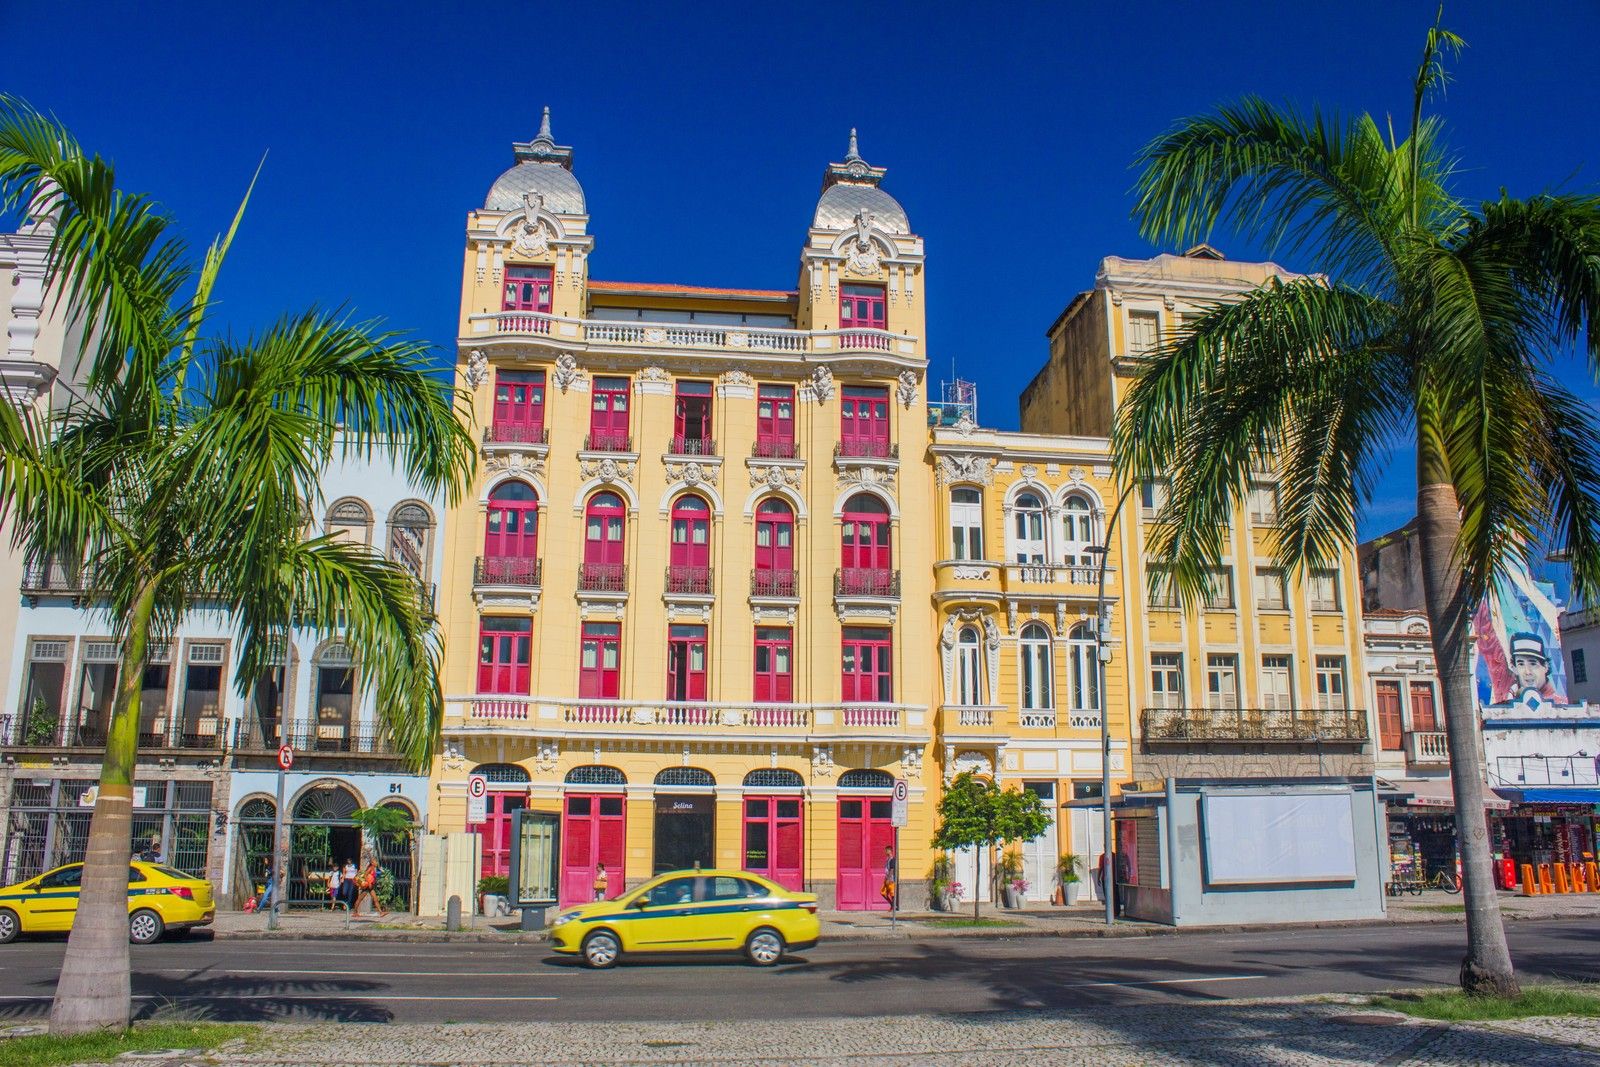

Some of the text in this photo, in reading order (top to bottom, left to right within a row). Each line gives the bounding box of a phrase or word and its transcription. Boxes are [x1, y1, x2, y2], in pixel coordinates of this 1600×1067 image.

[389, 783, 402, 794] 51
[474, 781, 481, 793] E
[898, 785, 904, 797] E
[1085, 785, 1091, 793] 9
[672, 801, 693, 809] Selina
